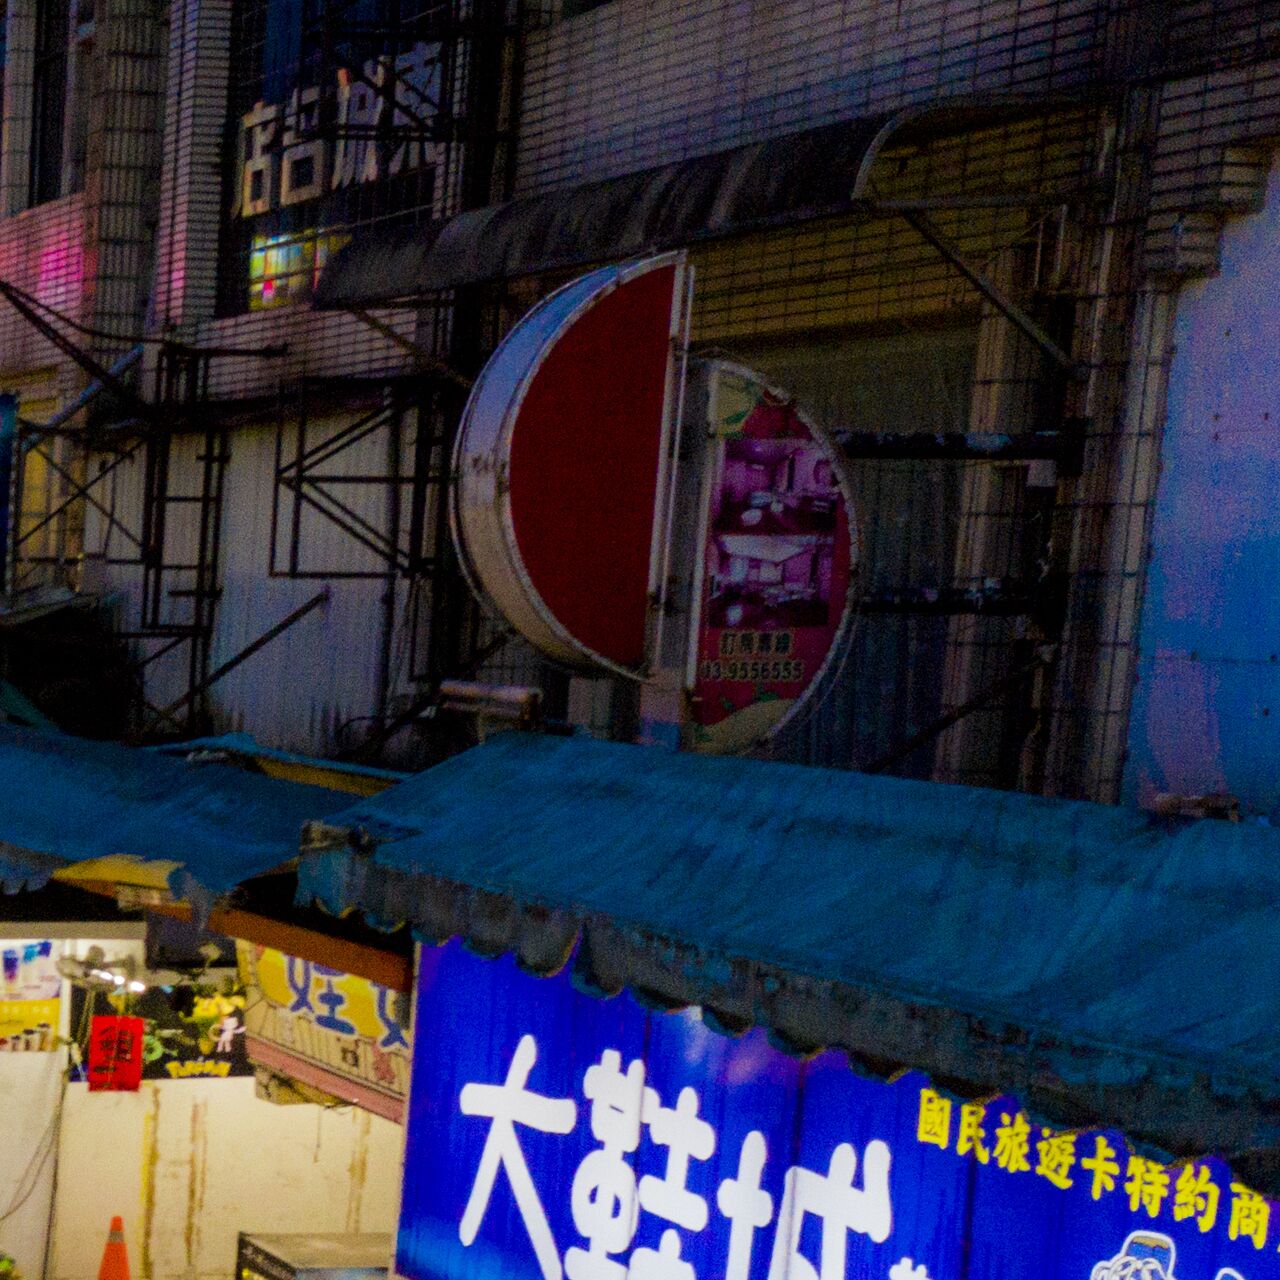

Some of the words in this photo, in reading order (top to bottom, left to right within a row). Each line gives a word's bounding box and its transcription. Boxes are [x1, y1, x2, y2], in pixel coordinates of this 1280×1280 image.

[916, 1087, 1280, 1252] 國民旅遊卡特約商
